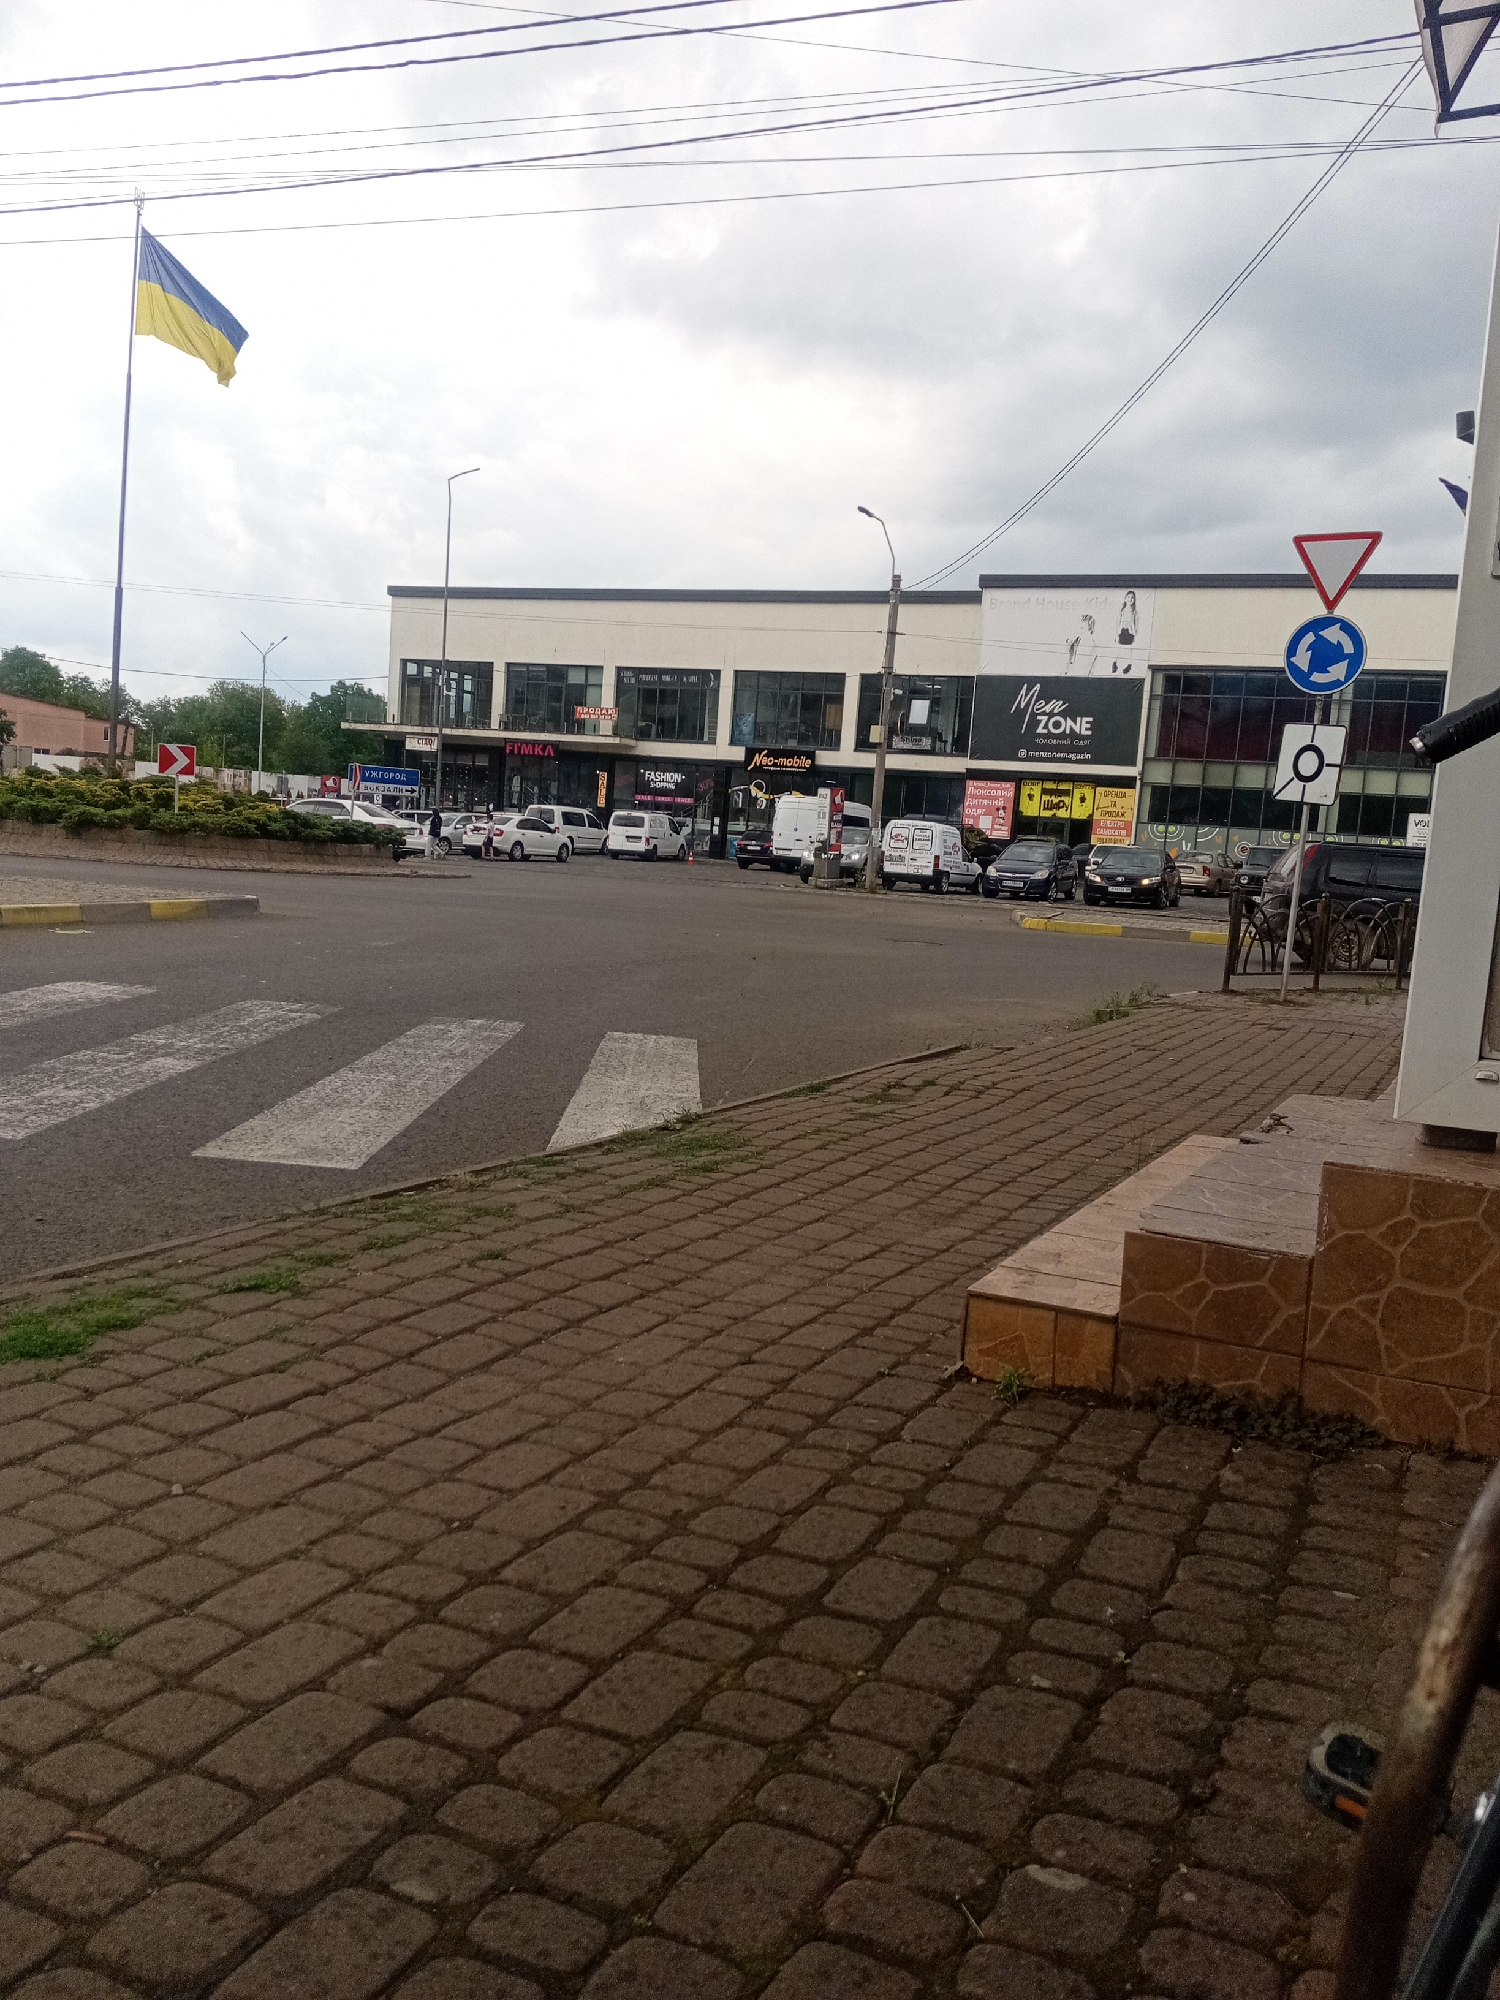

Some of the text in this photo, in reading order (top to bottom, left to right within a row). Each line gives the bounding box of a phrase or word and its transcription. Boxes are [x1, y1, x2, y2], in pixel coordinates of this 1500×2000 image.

[990, 597, 1031, 611] Brand
[1036, 598, 1080, 611] House
[577, 707, 616, 715] ПРОДАЮ
[1010, 683, 1069, 734] Men
[1036, 715, 1094, 735] ZONE
[747, 749, 812, 771] Neo-mobile
[1028, 750, 1091, 761] menzonemagazin
[365, 770, 407, 781] УЖГОРОД
[645, 771, 682, 783] FASHION
[364, 785, 404, 794] ВОКЗАЛИ
[598, 772, 607, 806] SALE
[650, 782, 676, 790] SHOPPING
[968, 786, 1013, 798] Люксовий
[1103, 790, 1127, 799] ОРЕНДА
[966, 798, 1005, 807] дитячий
[1110, 800, 1117, 809] ТА
[965, 808, 986, 816] одяг
[1100, 810, 1127, 819] ПРОДАЖ
[1100, 820, 1125, 828] ЕЛЕКТРО
